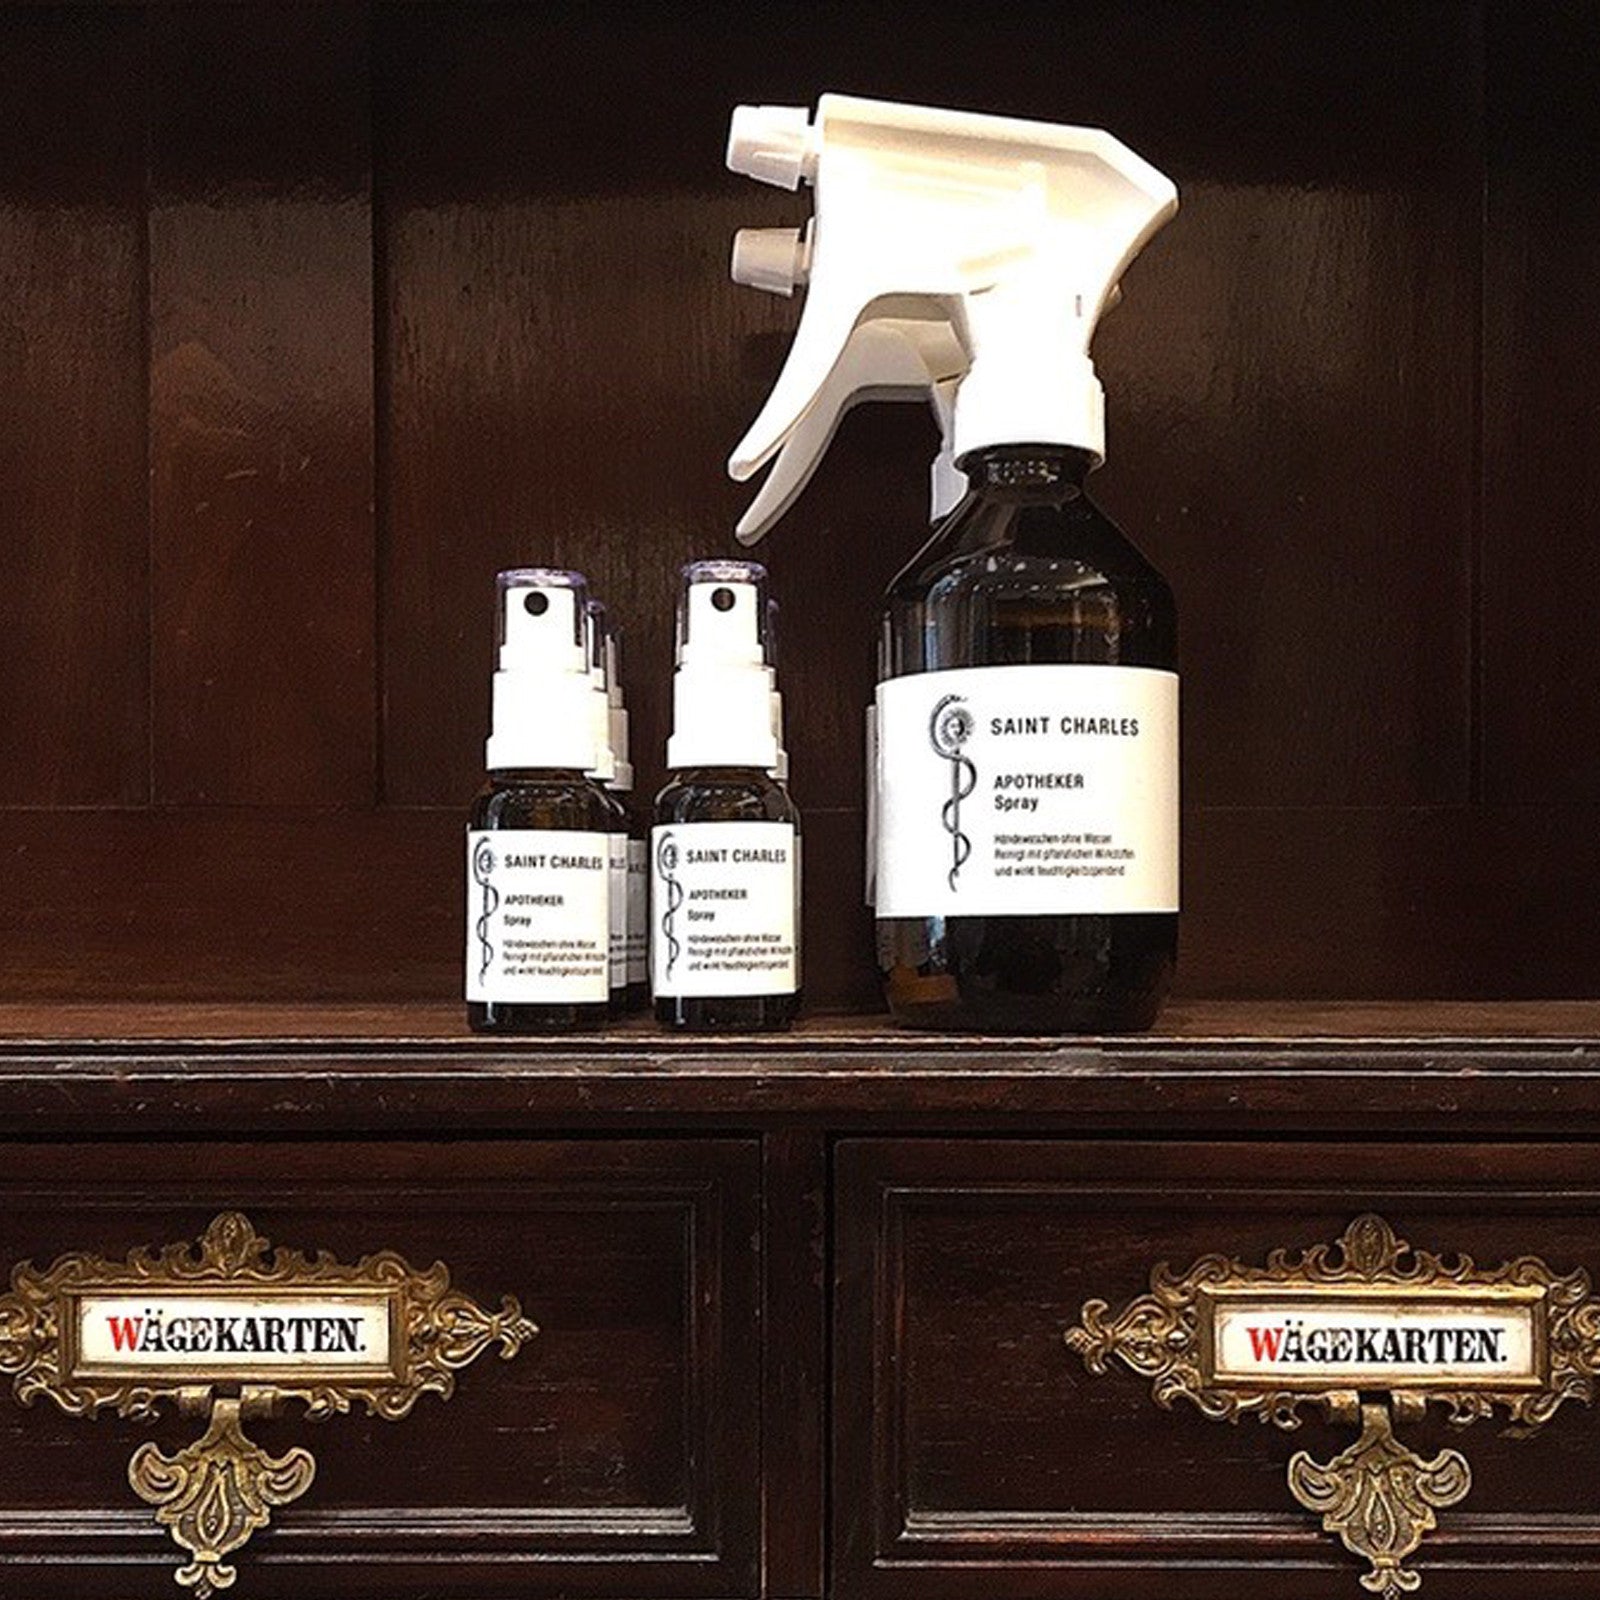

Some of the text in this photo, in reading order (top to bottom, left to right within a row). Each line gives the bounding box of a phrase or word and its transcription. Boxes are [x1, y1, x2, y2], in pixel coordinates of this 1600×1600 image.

[991, 717, 1139, 736] SAINT CHARLES
[994, 773, 1084, 790] APOTHEKER
[994, 795, 1039, 812] Spray
[504, 854, 546, 869] SAINT
[549, 854, 603, 870] CHARLES
[687, 849, 786, 864] SAINT CHARLES
[504, 894, 564, 906] APOTHEKER
[689, 889, 747, 900] APOTHEKER
[503, 915, 532, 927] Spray
[687, 910, 715, 922] Spray
[106, 1308, 366, 1353] WÄGEKARTEN.
[1247, 1320, 1507, 1363] WÄGEKARTEN.
